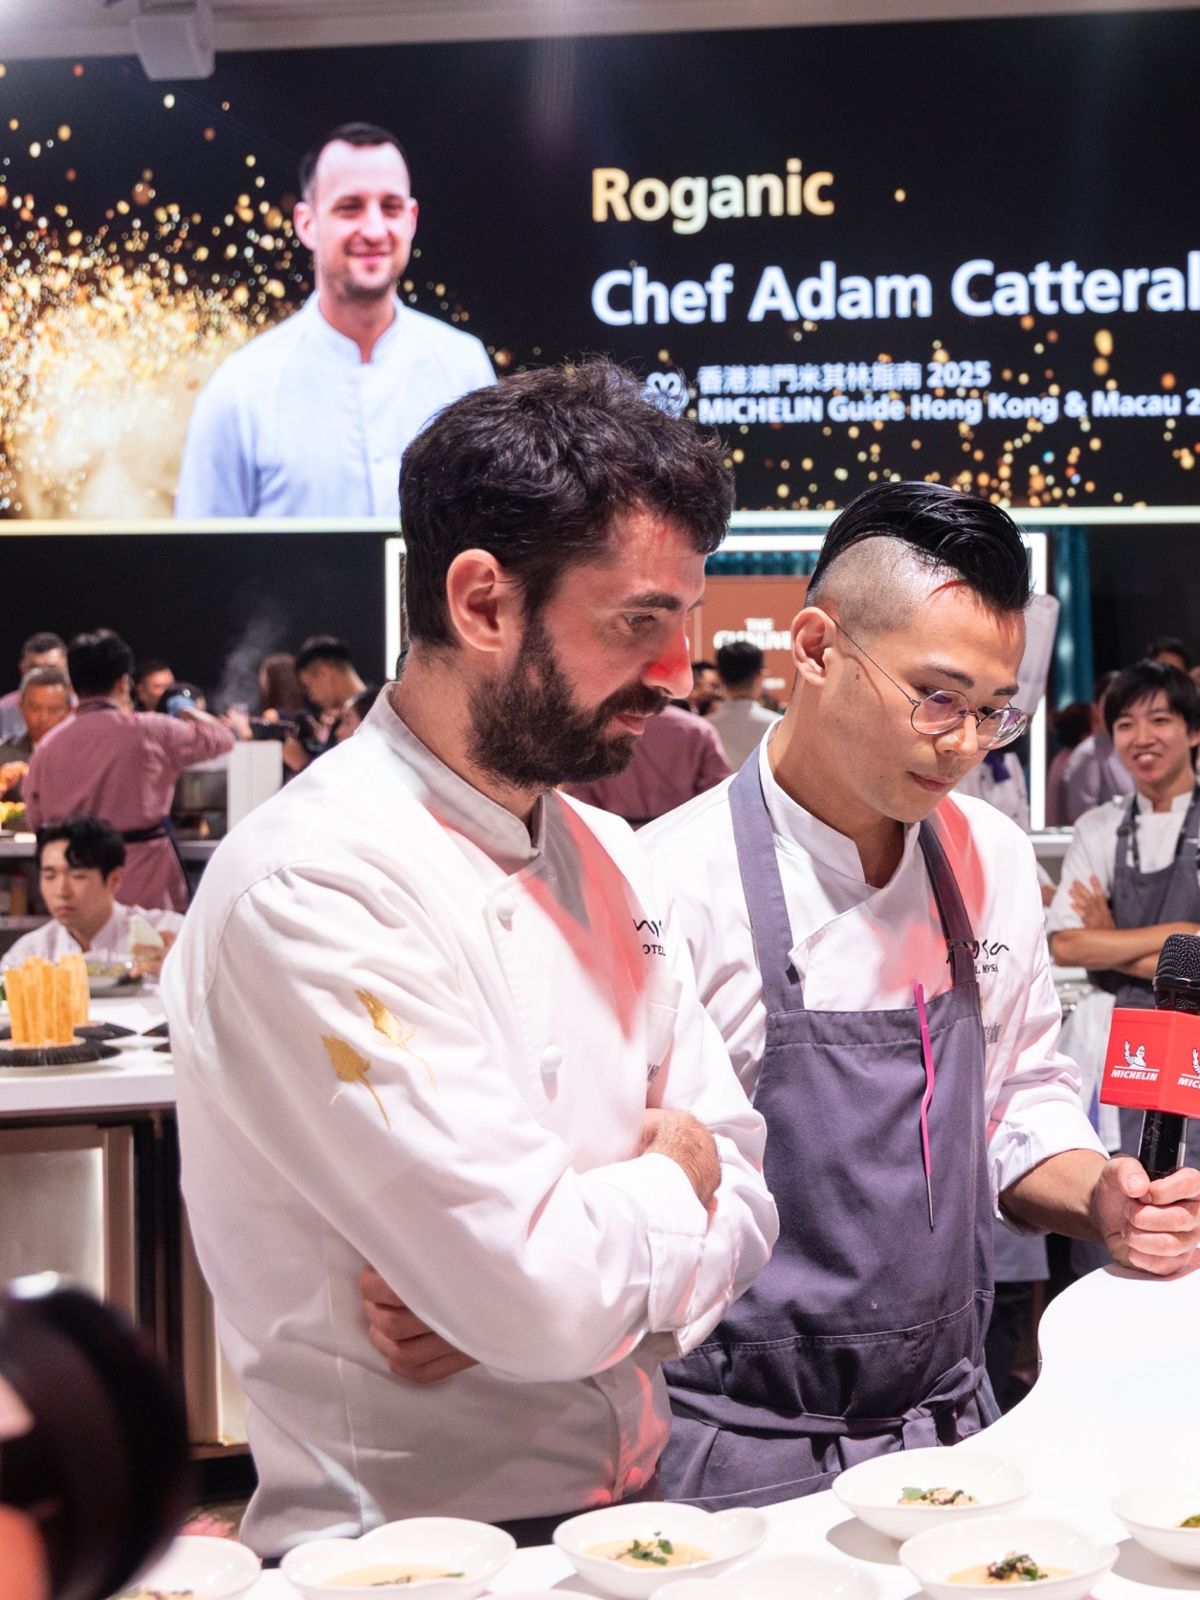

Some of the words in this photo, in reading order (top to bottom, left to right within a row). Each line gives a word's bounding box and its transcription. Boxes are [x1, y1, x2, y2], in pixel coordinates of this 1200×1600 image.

[592, 157, 835, 235] Roganic
[591, 263, 734, 326] Chef
[747, 260, 933, 322] Adam
[926, 360, 992, 388] 2025
[698, 397, 823, 424] MICHELIN
[827, 389, 905, 422] Guide
[910, 394, 983, 425] Hong
[987, 391, 1060, 424] Kong
[1063, 390, 1087, 419] &
[1091, 389, 1182, 418] Macau
[1110, 1069, 1159, 1082] MICHELIN
